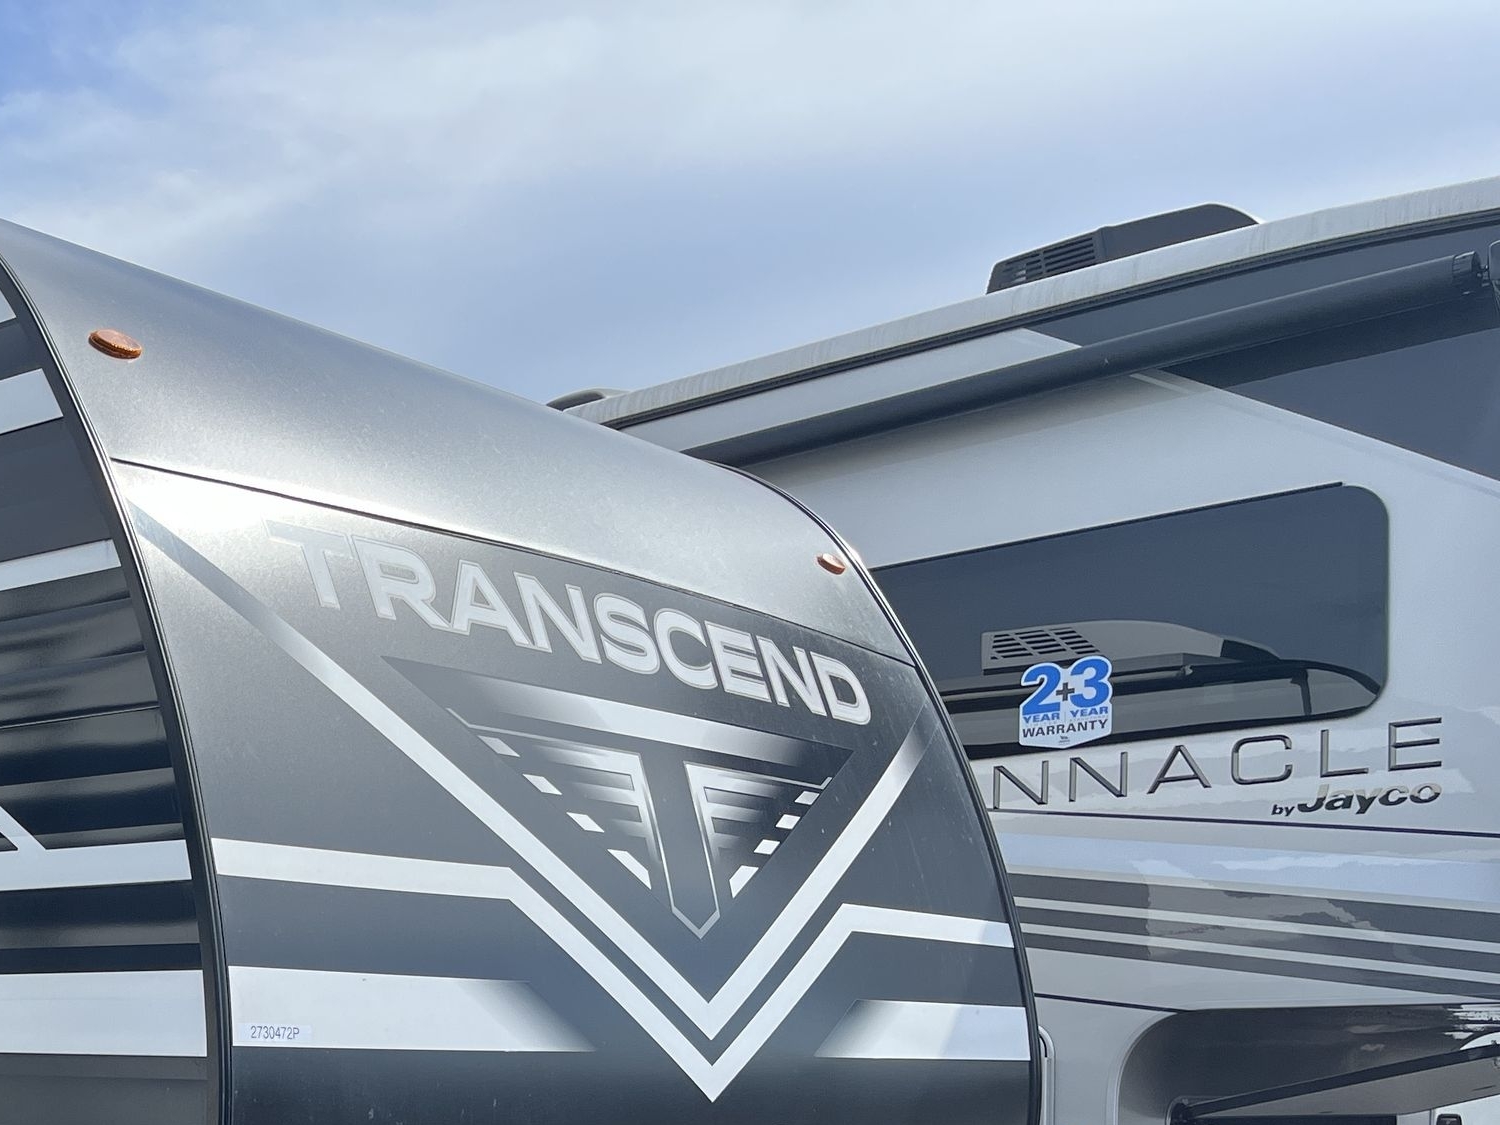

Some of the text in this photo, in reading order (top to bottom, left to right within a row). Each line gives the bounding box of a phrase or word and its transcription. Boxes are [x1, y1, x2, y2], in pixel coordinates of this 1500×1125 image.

[265, 519, 871, 726] TRANSCEND
[1023, 713, 1060, 724] YEAR
[1070, 706, 1109, 718] YEAR
[1022, 719, 1109, 738] WARRANTY
[1271, 782, 1443, 817] by Jayco
[250, 1025, 300, 1040] 2730472P
